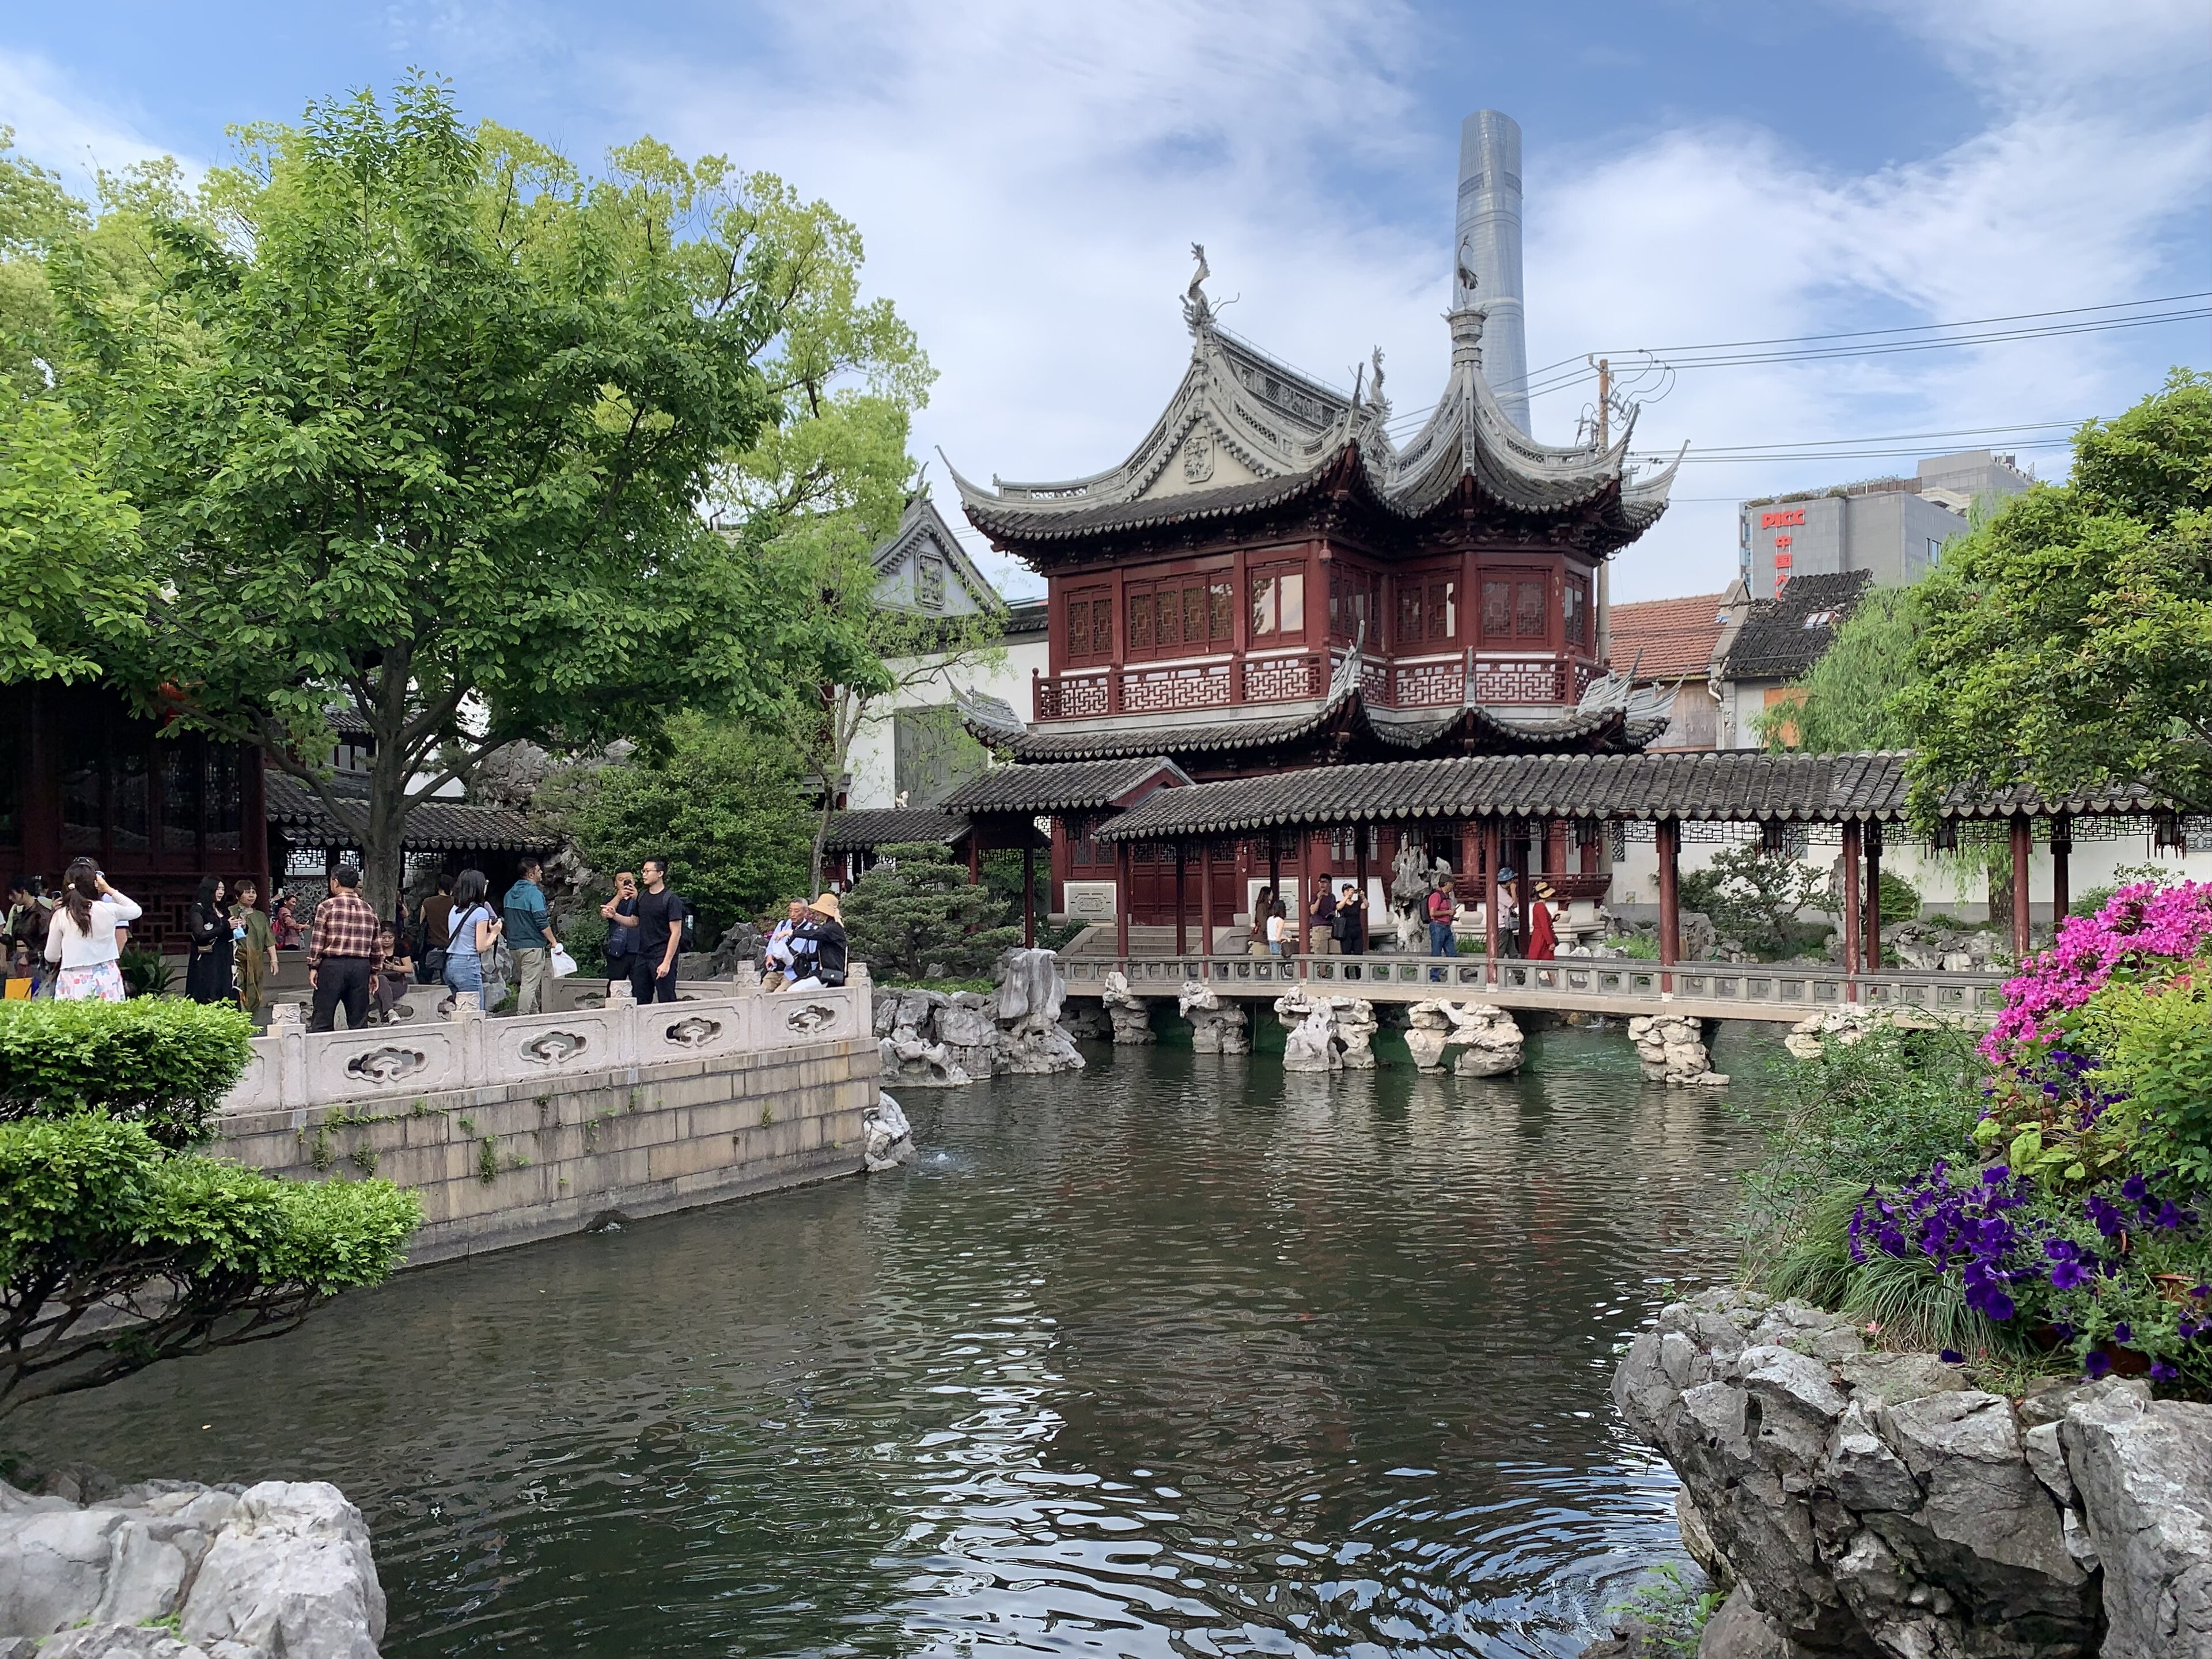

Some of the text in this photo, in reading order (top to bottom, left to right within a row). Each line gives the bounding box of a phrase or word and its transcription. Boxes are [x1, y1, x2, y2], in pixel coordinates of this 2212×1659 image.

[1762, 509, 1805, 529] PICC
[1774, 535, 1792, 599] 中国人
